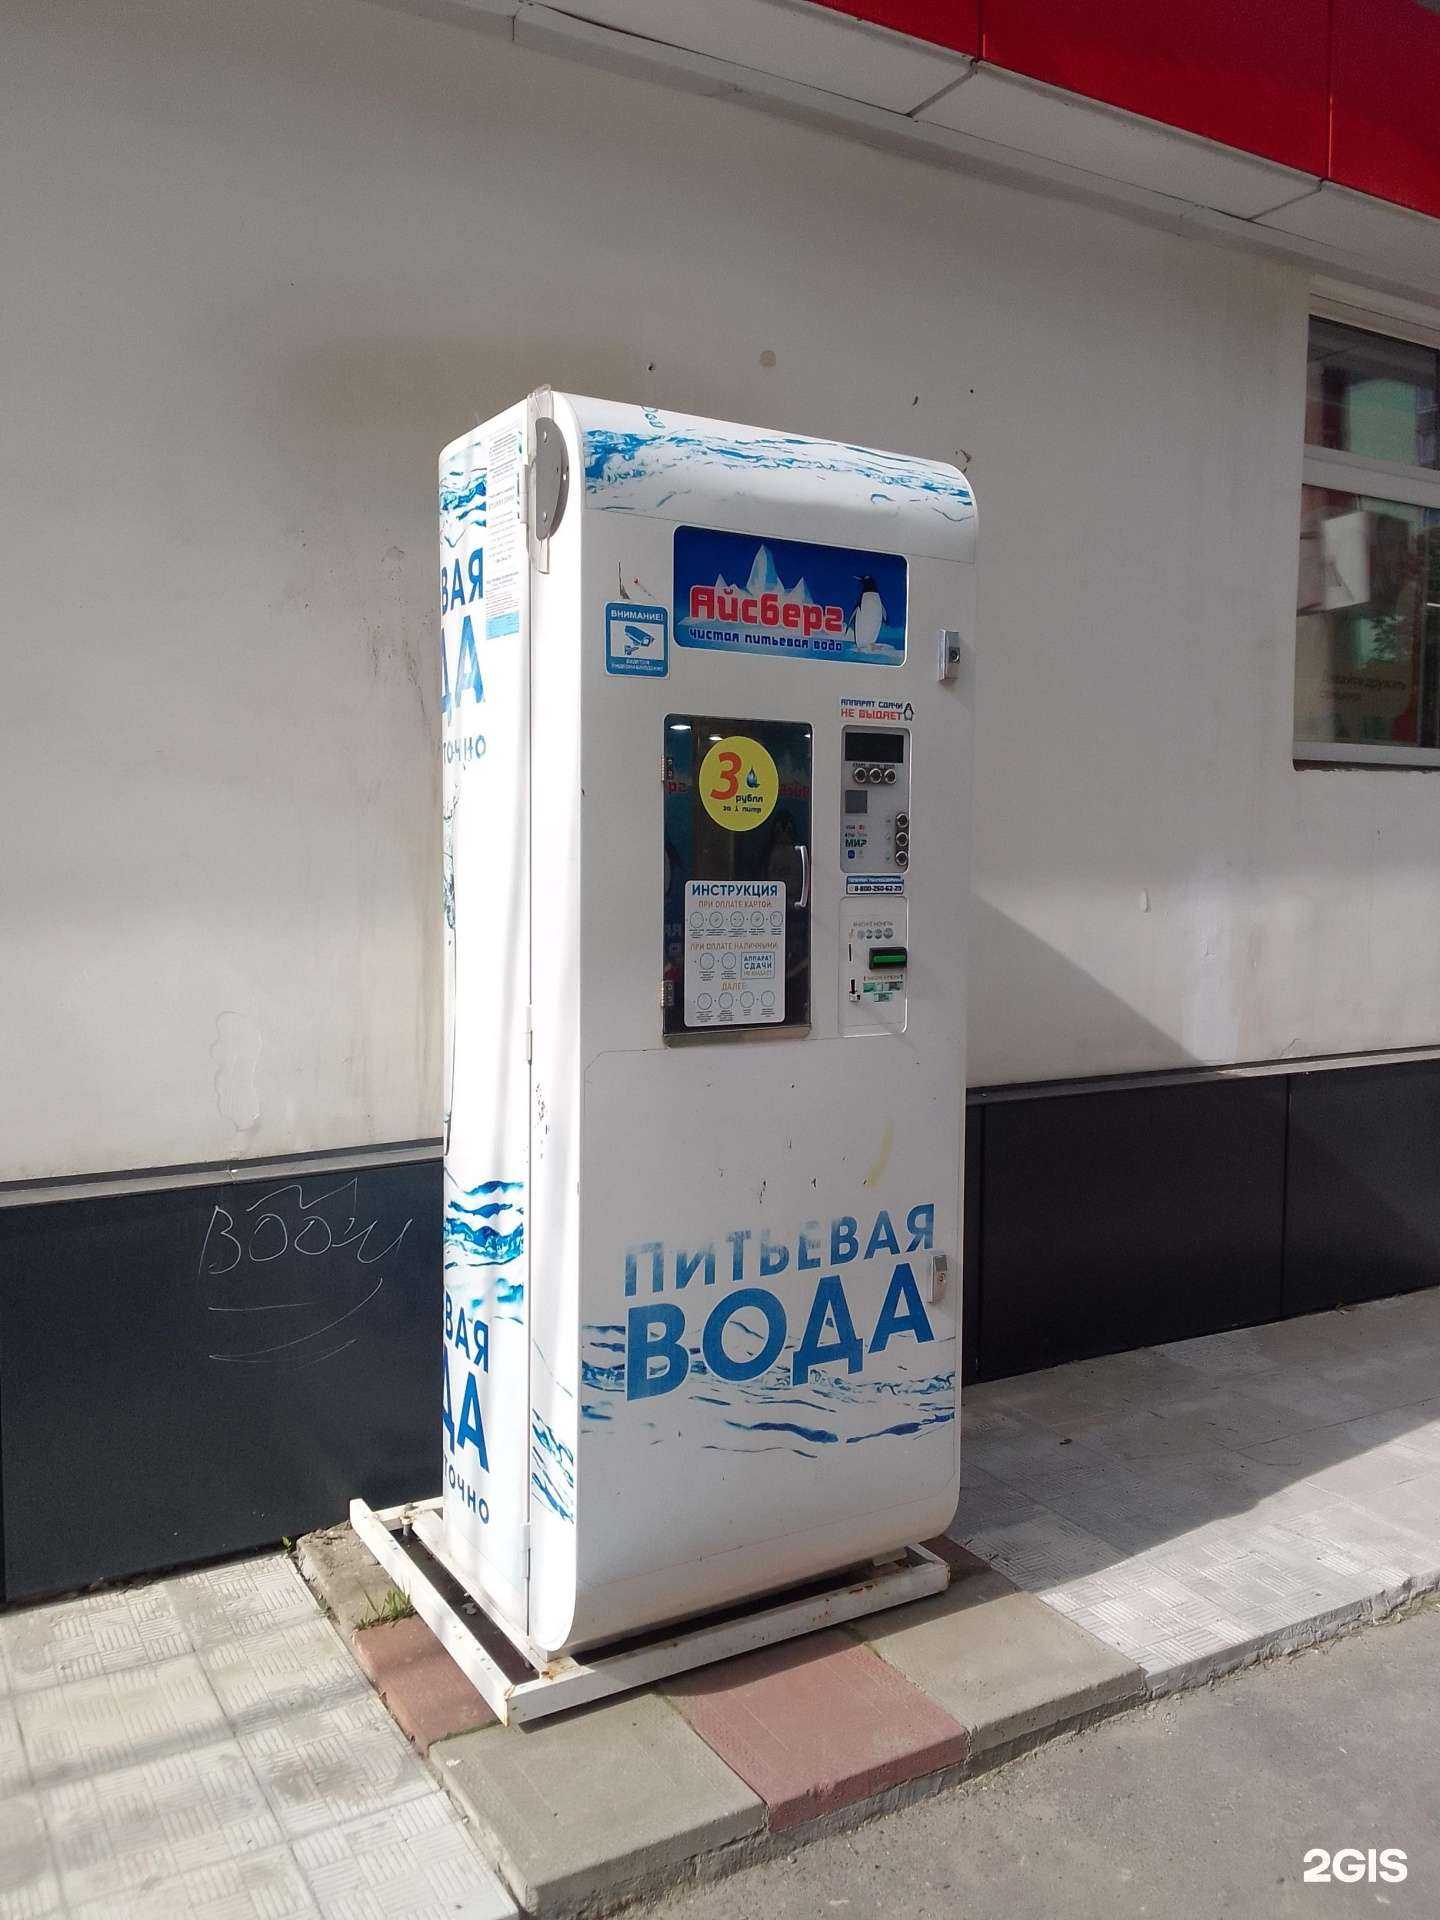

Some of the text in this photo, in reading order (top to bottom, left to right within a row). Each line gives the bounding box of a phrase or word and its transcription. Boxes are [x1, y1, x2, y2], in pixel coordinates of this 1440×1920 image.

[610, 609, 664, 621] ВНИМАНИЕ!
[690, 585, 845, 636] Айсберг
[690, 627, 842, 651] чистая питьевая вода
[841, 709, 901, 721] НЕ ВЫДАЕТ
[879, 701, 904, 710] СДАЧИ
[710, 751, 742, 800] 3
[692, 884, 778, 898] ИНСТРУКЦИЯ
[743, 962, 772, 970] СДАЧИ
[624, 1203, 935, 1297] ПИТЬЕВАЯ
[625, 1263, 936, 1402] ВОДА
